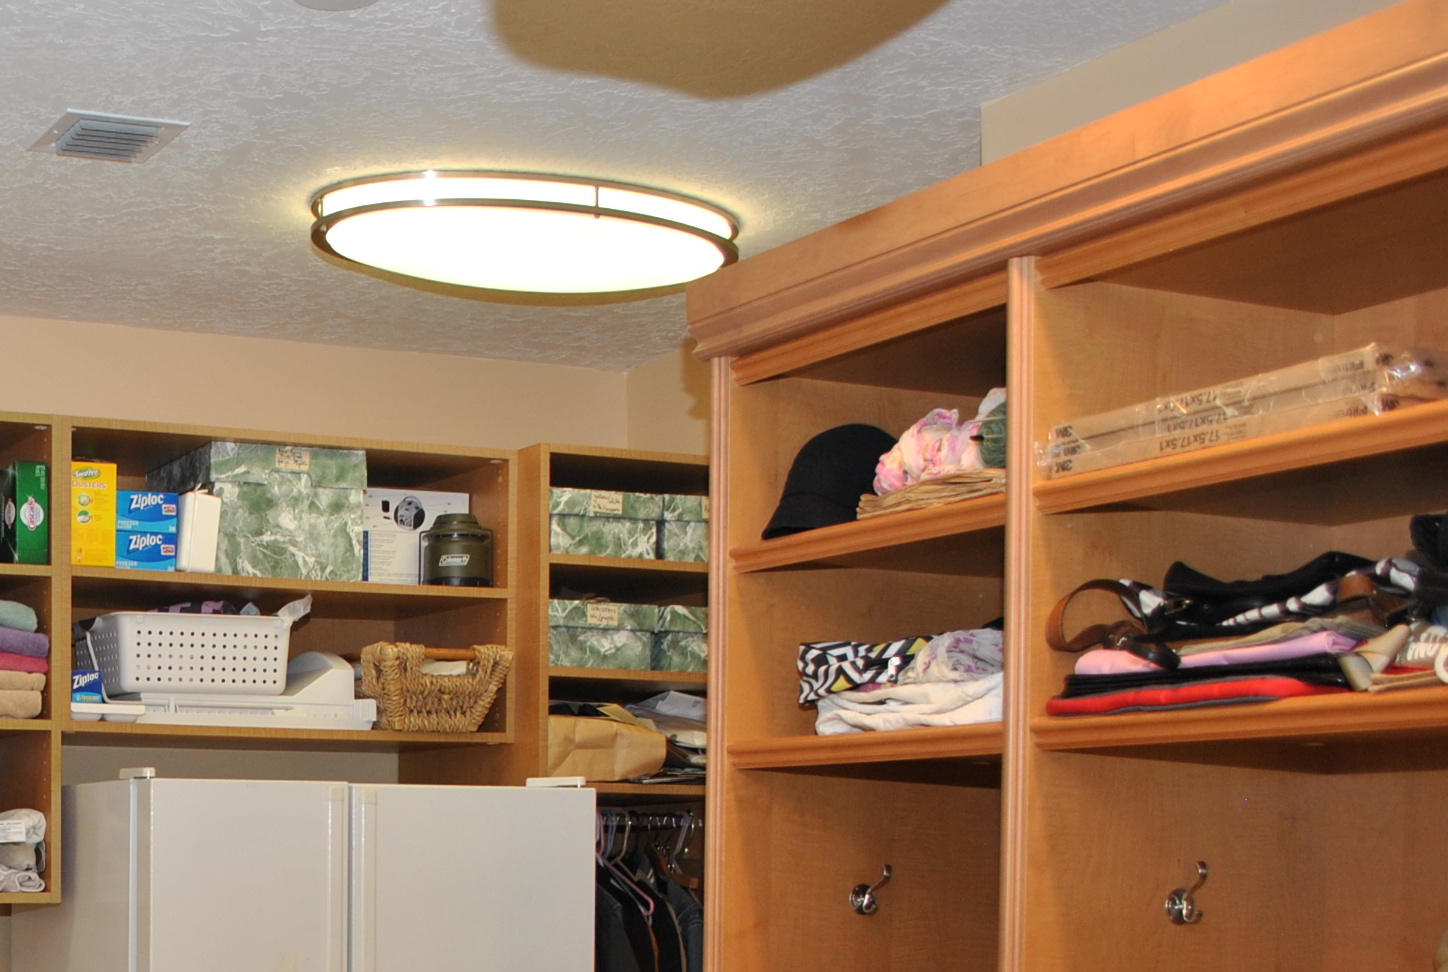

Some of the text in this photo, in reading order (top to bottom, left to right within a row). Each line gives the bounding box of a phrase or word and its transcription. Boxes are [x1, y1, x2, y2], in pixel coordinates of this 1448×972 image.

[1159, 430, 1220, 451] 17.5x17.5x1
[130, 493, 164, 510] Ziploc
[129, 533, 163, 551] Ziploc
[72, 672, 100, 690] Ziploc
